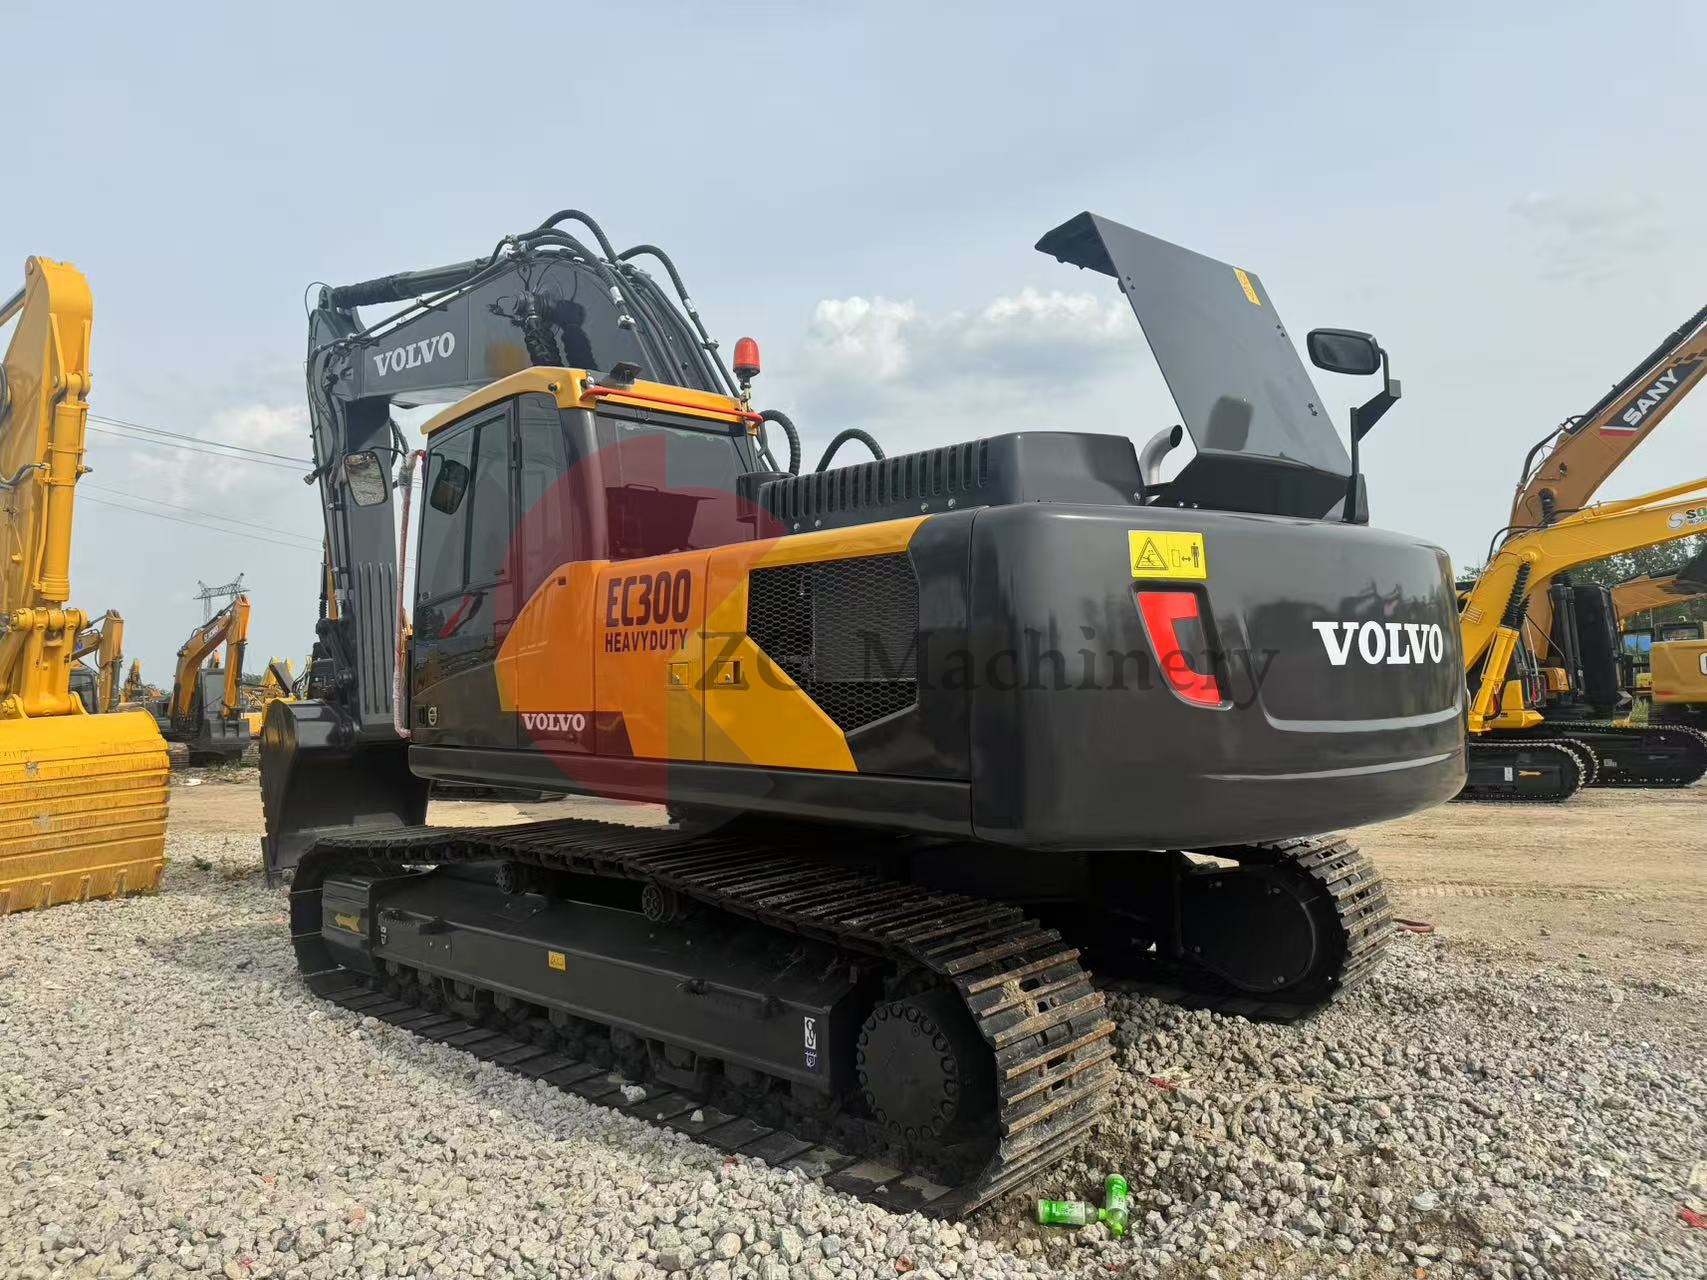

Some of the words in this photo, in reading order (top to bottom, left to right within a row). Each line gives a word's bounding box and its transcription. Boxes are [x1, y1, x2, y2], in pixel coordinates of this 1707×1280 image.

[373, 331, 456, 377] VOLVO
[1622, 367, 1679, 426] SANY
[606, 568, 692, 628] EC300
[604, 628, 688, 653] HEAVYDUTY
[1311, 620, 1444, 666] VOLVO
[521, 712, 586, 732] VOLVO
